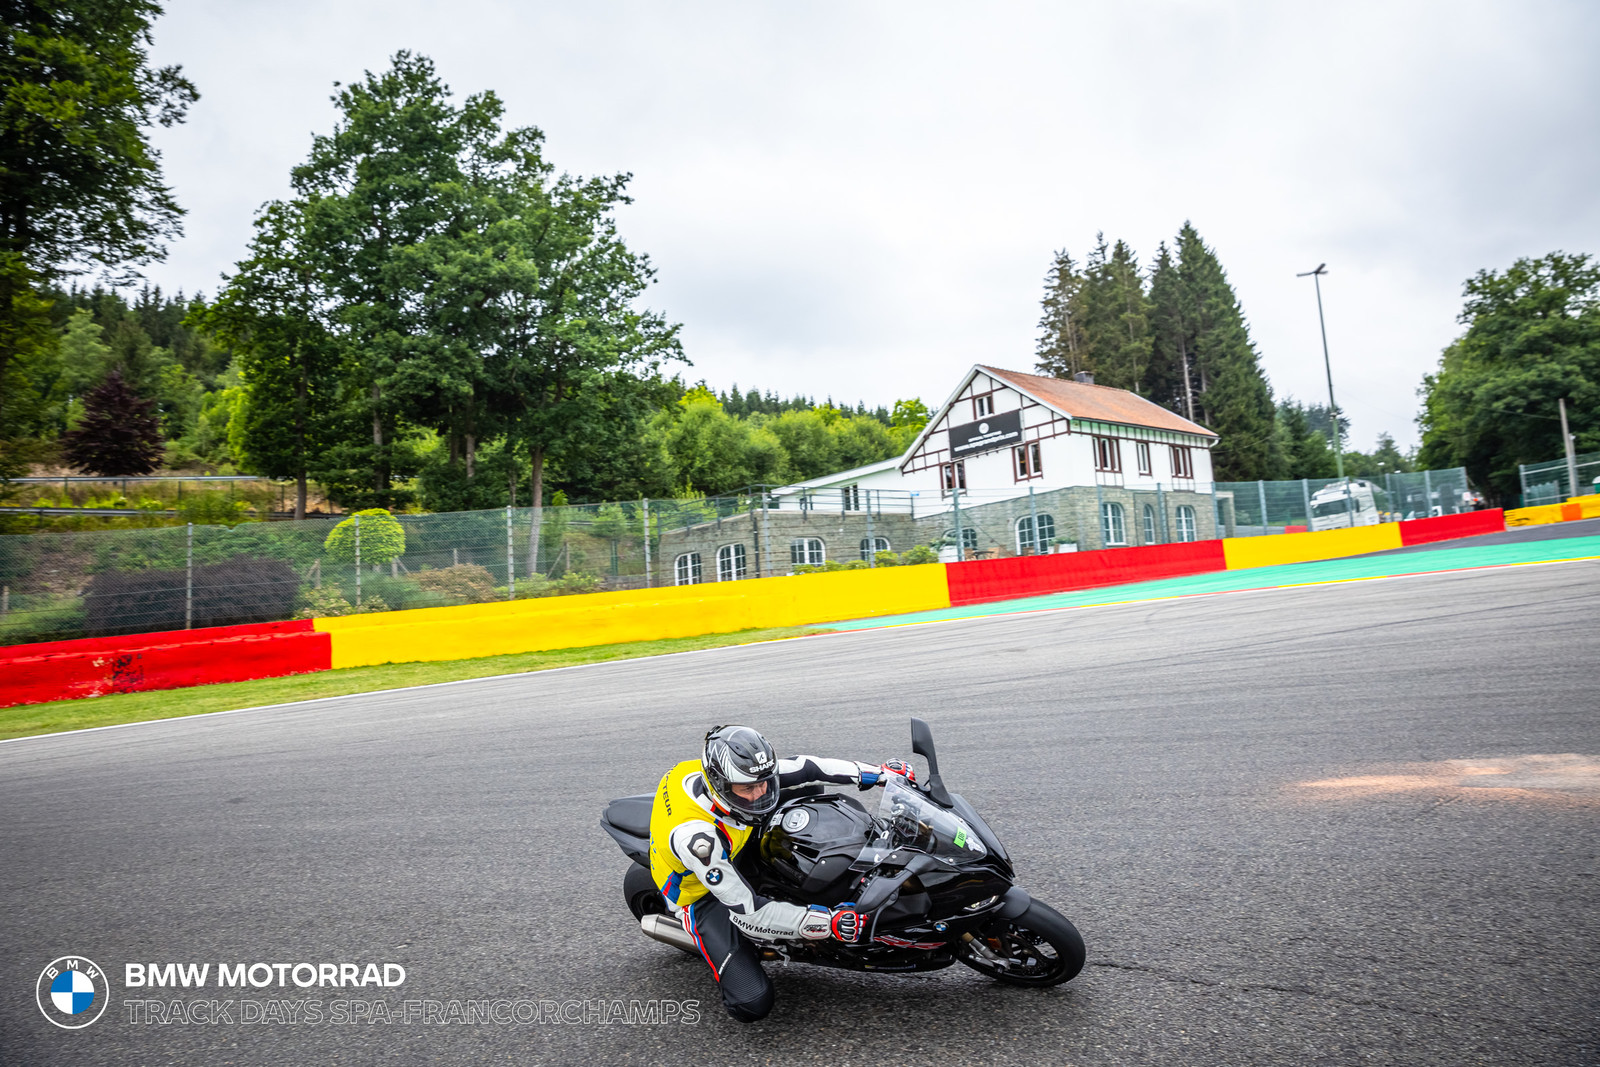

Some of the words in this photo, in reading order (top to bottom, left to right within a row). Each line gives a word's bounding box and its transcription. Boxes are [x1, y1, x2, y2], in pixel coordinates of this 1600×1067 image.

[749, 759, 775, 773] SHARK
[732, 915, 755, 931] BMW
[754, 926, 794, 936] Motorrad
